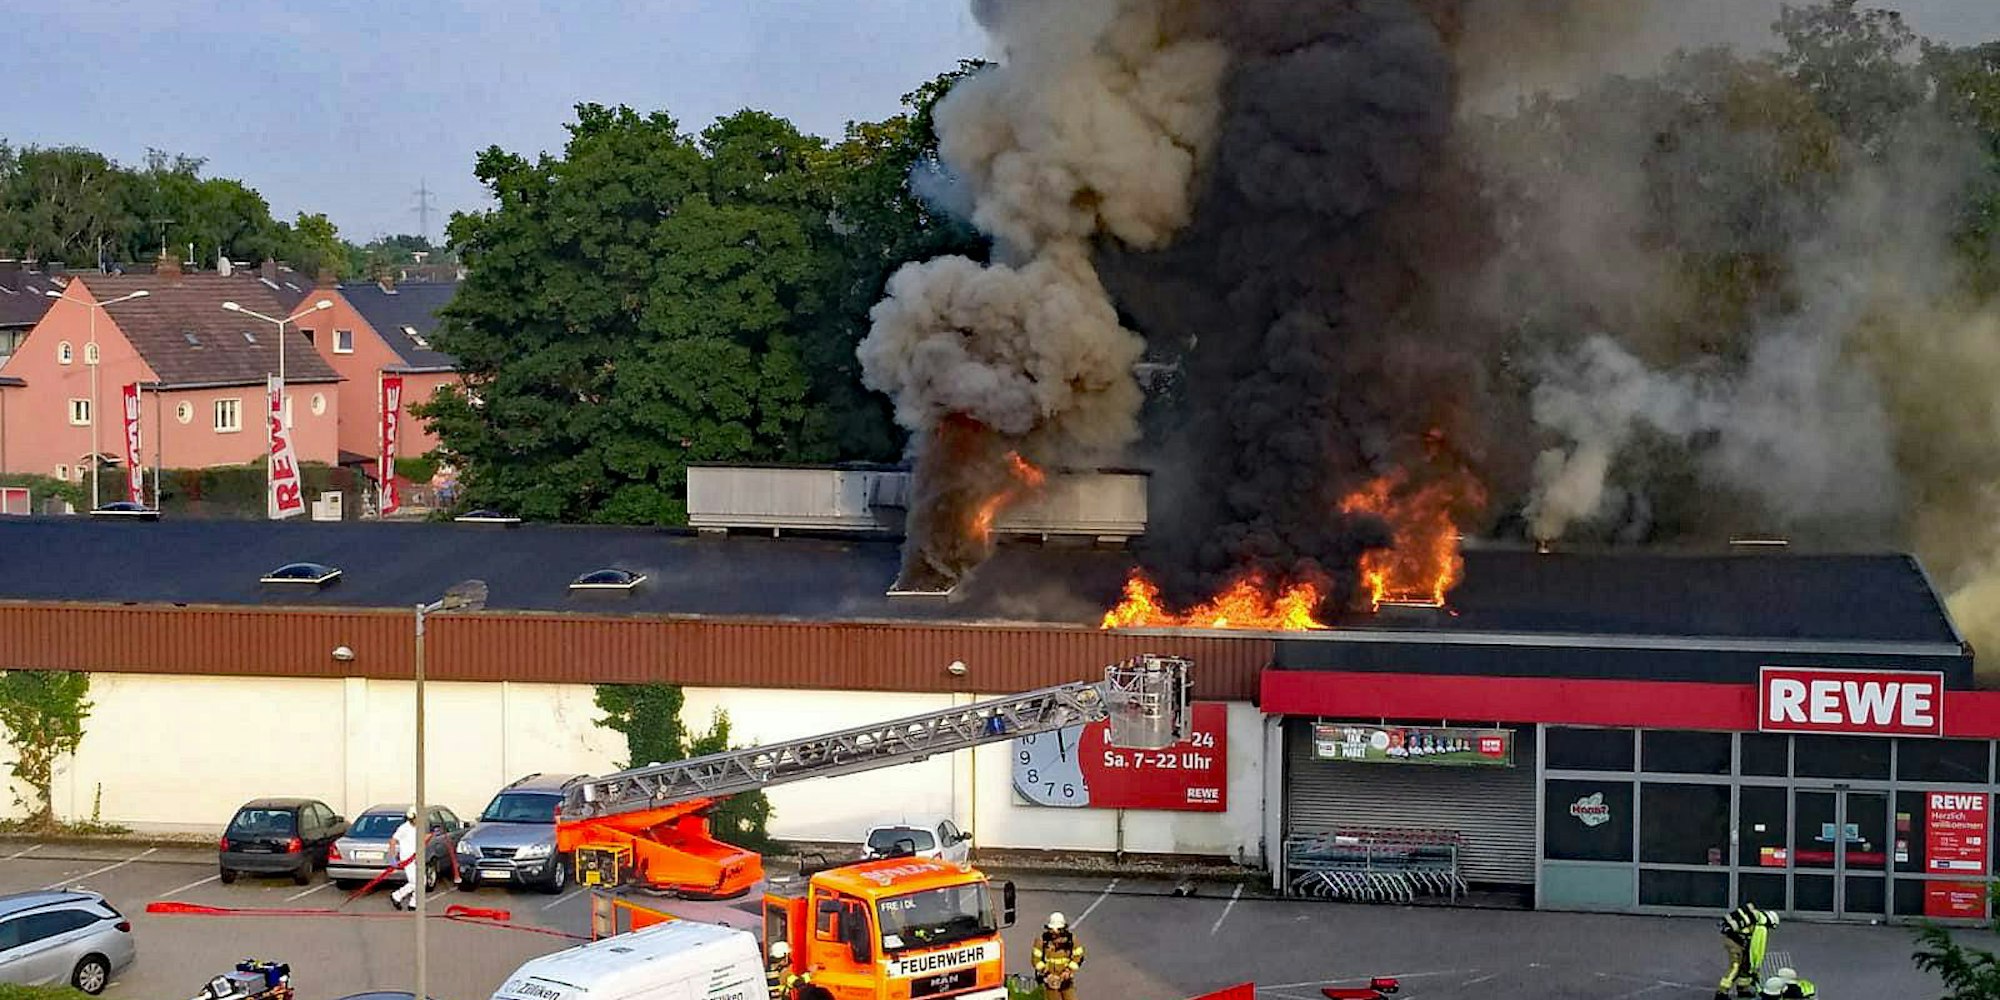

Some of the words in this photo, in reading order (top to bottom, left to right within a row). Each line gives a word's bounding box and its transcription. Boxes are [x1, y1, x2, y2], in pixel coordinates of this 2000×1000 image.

[271, 388, 301, 511] REWE
[1769, 678, 1934, 727] REWE
[1019, 750, 1031, 765] 9
[1104, 750, 1129, 768] Sa.
[1134, 752, 1178, 769] 7–22
[1182, 752, 1212, 770] Uhr
[1027, 769, 1039, 783] 8
[1043, 782, 1055, 796] 7
[1063, 783, 1074, 798] 6
[1187, 787, 1219, 799] REWE
[1931, 794, 1983, 811] REWE
[1931, 811, 1967, 821] Herzlich
[1931, 821, 1984, 830] willkommen
[900, 946, 985, 975] FEUERWEHR
[930, 974, 959, 987] MAN
